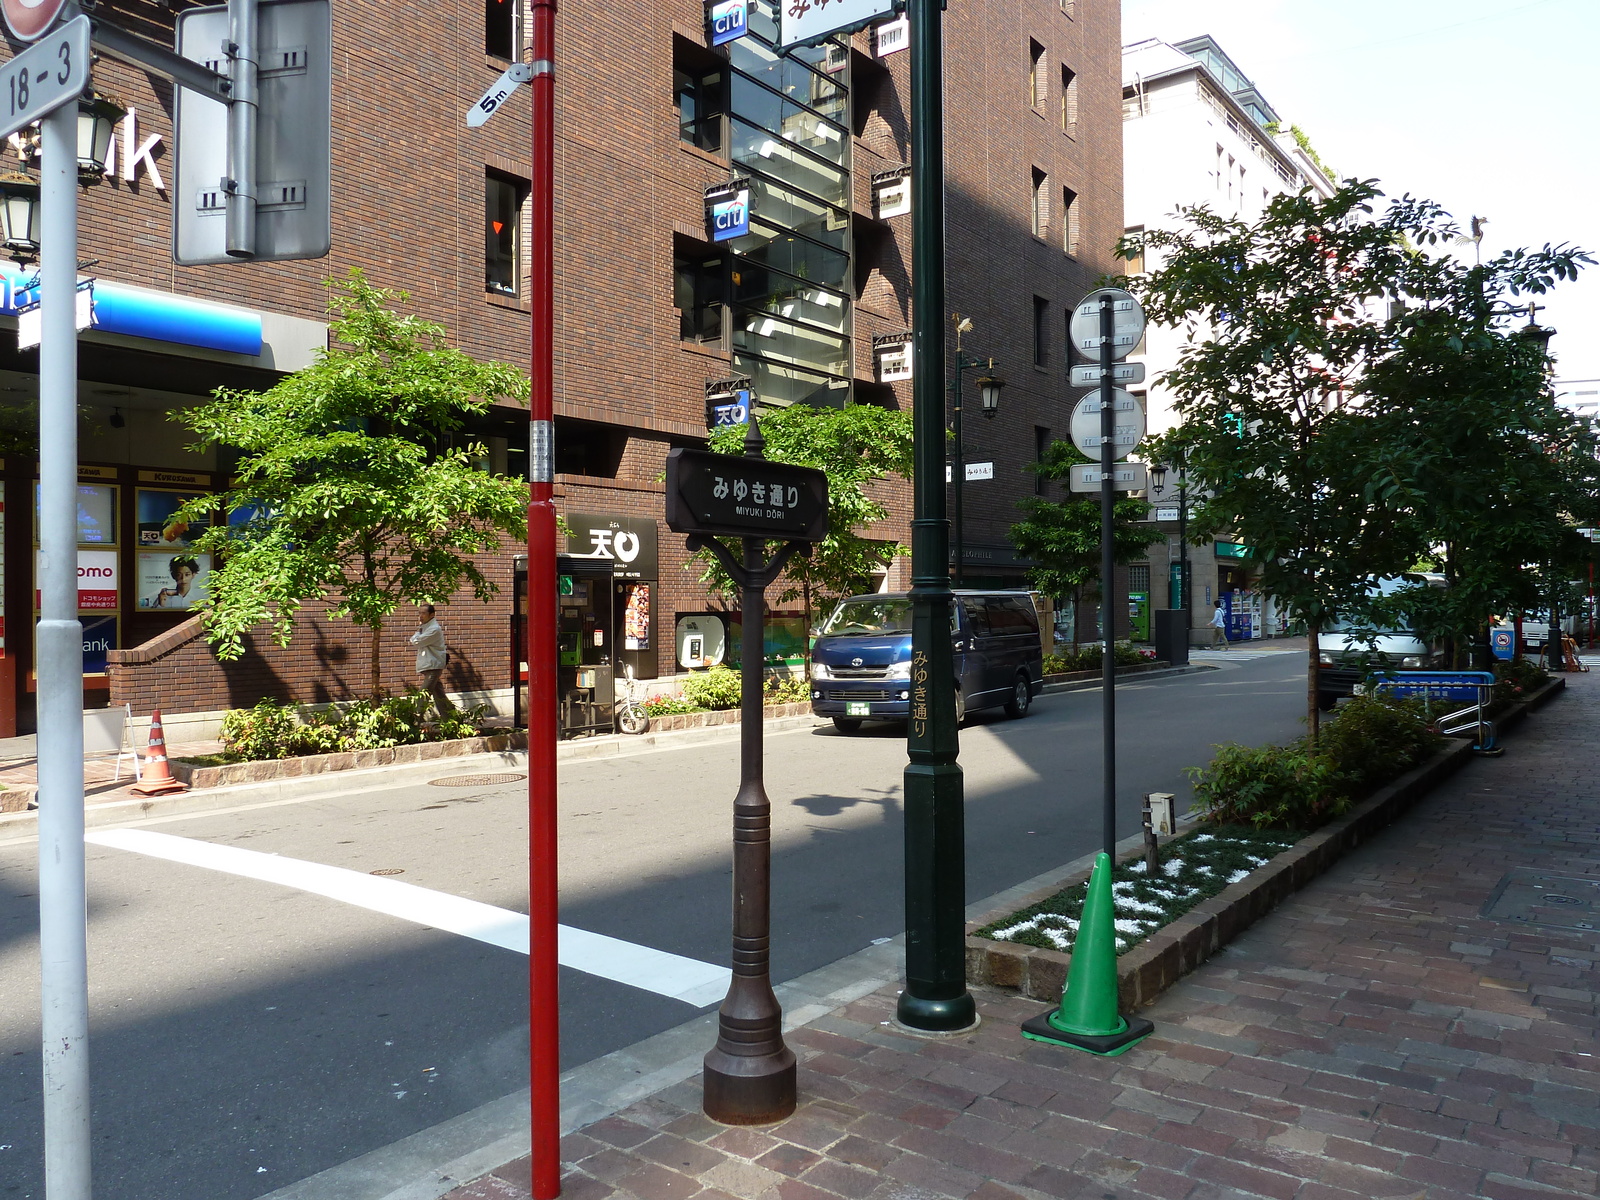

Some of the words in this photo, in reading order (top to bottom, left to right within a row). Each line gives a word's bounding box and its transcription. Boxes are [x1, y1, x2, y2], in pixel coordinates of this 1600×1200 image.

[715, 10, 743, 34] citi
[480, 90, 507, 113] 5m
[716, 206, 744, 229] citi
[78, 467, 101, 476] SAWA
[713, 476, 799, 508] みゆき通り
[736, 506, 763, 517] MIYUKI
[912, 650, 929, 738] みゆき通り
